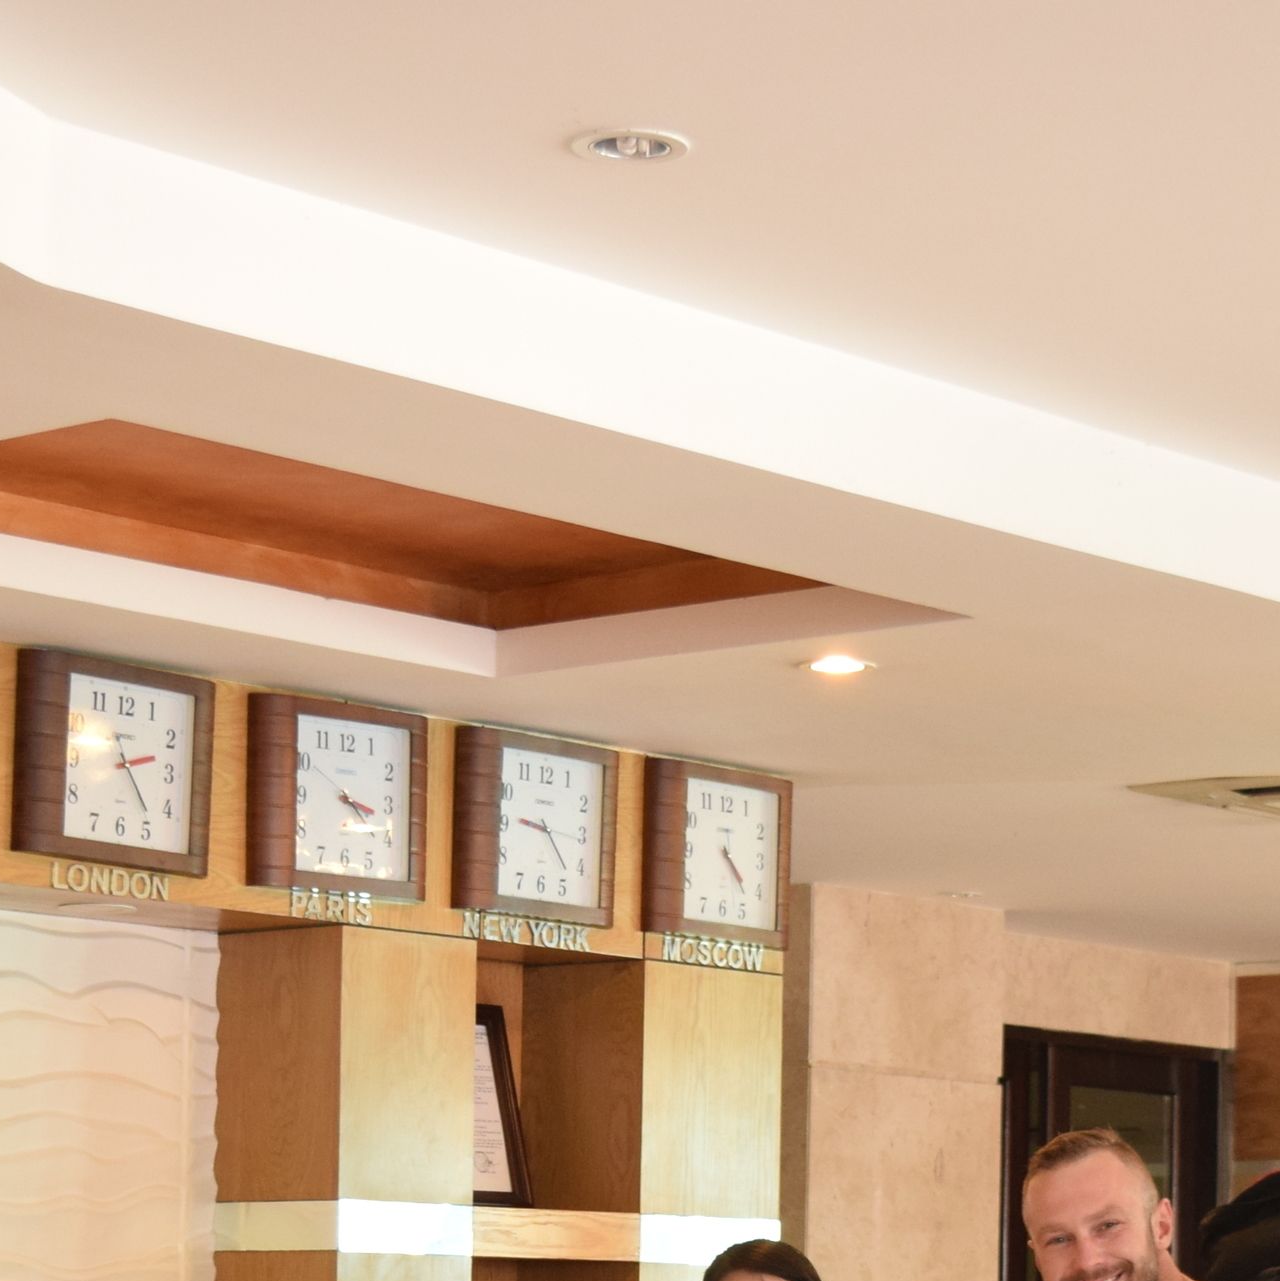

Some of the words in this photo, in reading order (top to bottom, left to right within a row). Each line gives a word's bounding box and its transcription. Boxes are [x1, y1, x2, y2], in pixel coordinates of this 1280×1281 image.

[92, 691, 106, 712] 11
[118, 696, 134, 716] 12
[149, 702, 155, 721] 1
[166, 729, 176, 749] 2
[316, 730, 329, 750] 11
[340, 734, 355, 753] 12
[368, 738, 373, 756] 1
[70, 748, 79, 768] 9
[164, 764, 173, 784] 3
[385, 763, 393, 781] 2
[519, 762, 529, 781] 11
[540, 766, 553, 785] 12
[565, 771, 570, 788] 1
[68, 784, 78, 804] 8
[298, 785, 306, 804] 9
[701, 792, 712, 810] 11
[163, 799, 172, 819] 4
[384, 796, 393, 815] 3
[580, 795, 588, 813] 2
[721, 796, 733, 813] 12
[744, 800, 748, 816] 1
[89, 812, 100, 832] 7
[115, 816, 125, 836] 6
[141, 821, 151, 840] 5
[500, 814, 509, 832] 9
[384, 830, 392, 848] 4
[578, 826, 586, 845] 3
[757, 824, 764, 840] 2
[317, 846, 325, 864] 7
[341, 848, 349, 867] 6
[686, 842, 693, 859] 9
[365, 852, 373, 870] 5
[577, 858, 584, 876] 4
[756, 852, 764, 871] 3
[52, 861, 169, 900] LONDON
[516, 872, 524, 890] 7
[537, 875, 545, 893] 6
[558, 879, 566, 896] 5
[755, 883, 762, 901] 4
[291, 891, 371, 926] PARIS
[701, 897, 707, 914] 7
[719, 900, 726, 917] 6
[738, 903, 745, 920] 5
[463, 911, 522, 943] NEW
[527, 920, 589, 952] YORK
[662, 936, 763, 970] MOSCOW
